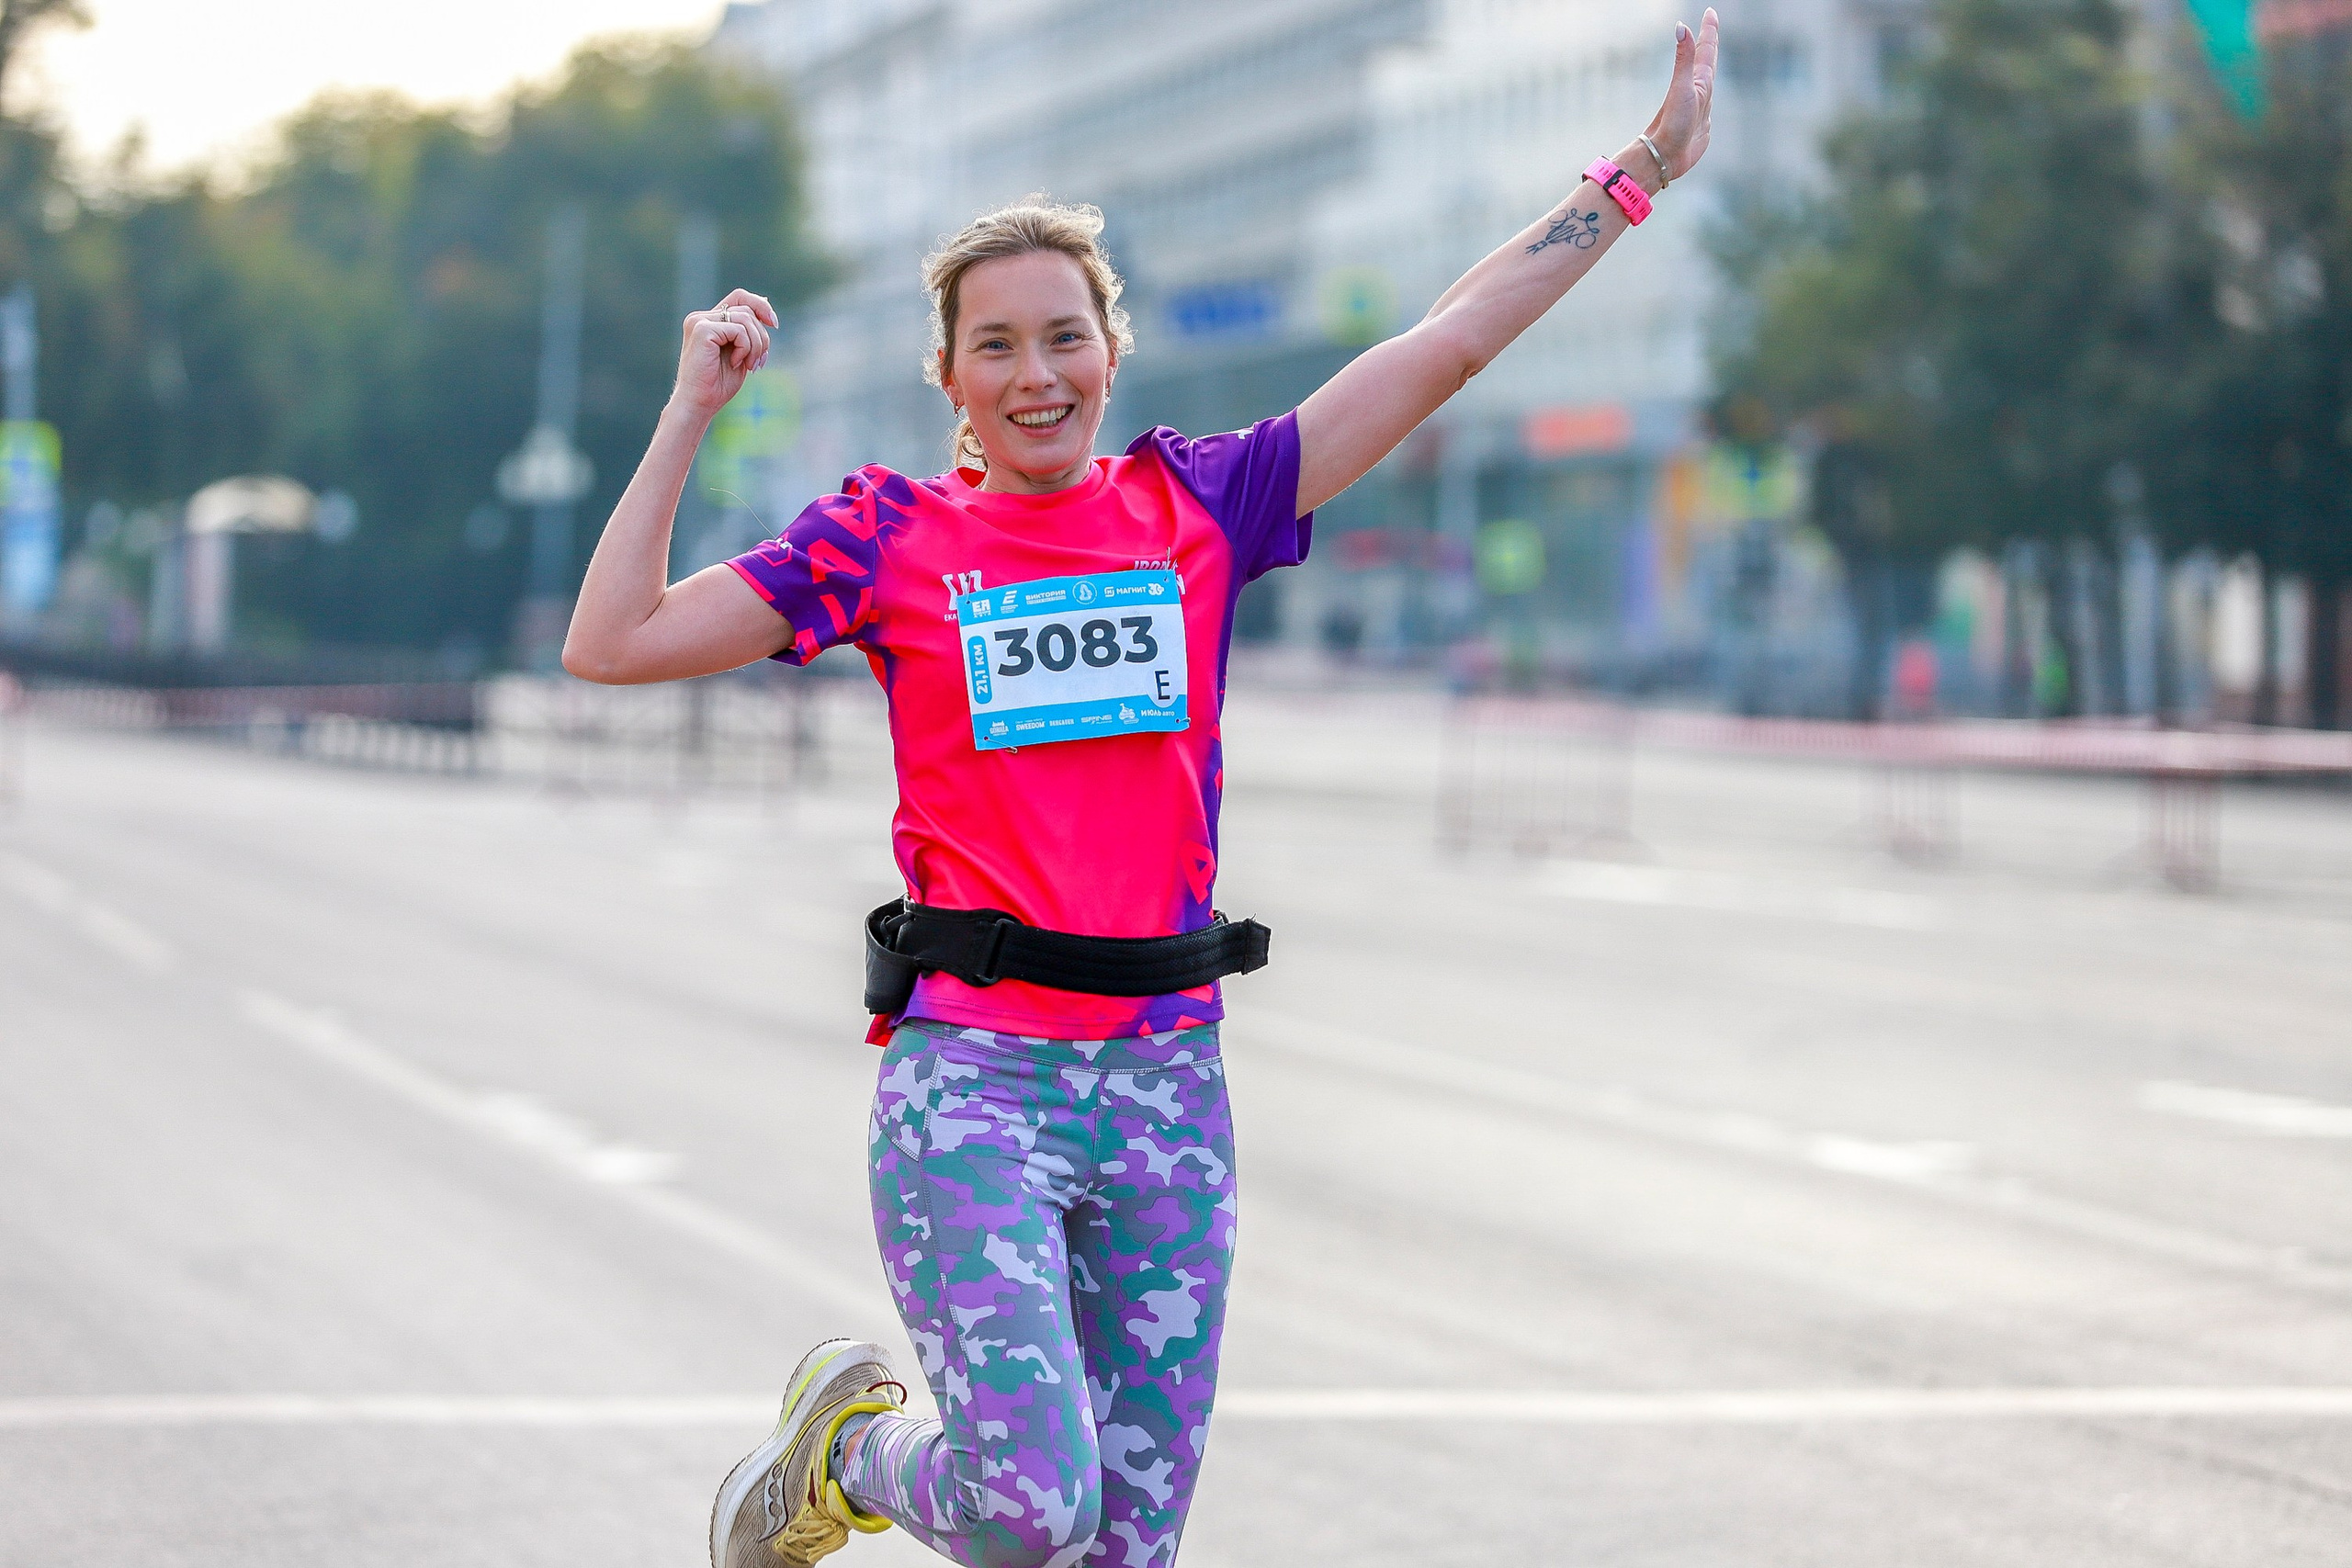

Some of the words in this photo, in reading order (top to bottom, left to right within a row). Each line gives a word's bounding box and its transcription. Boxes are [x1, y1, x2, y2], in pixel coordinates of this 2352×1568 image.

[1025, 590, 1066, 601] ВИКТОРИЯ
[1116, 586, 1147, 595] МАГНИТ
[994, 616, 1158, 676] 3083
[974, 670, 989, 694] 21,1
[1140, 709, 1161, 717] ИЮЛЬ
